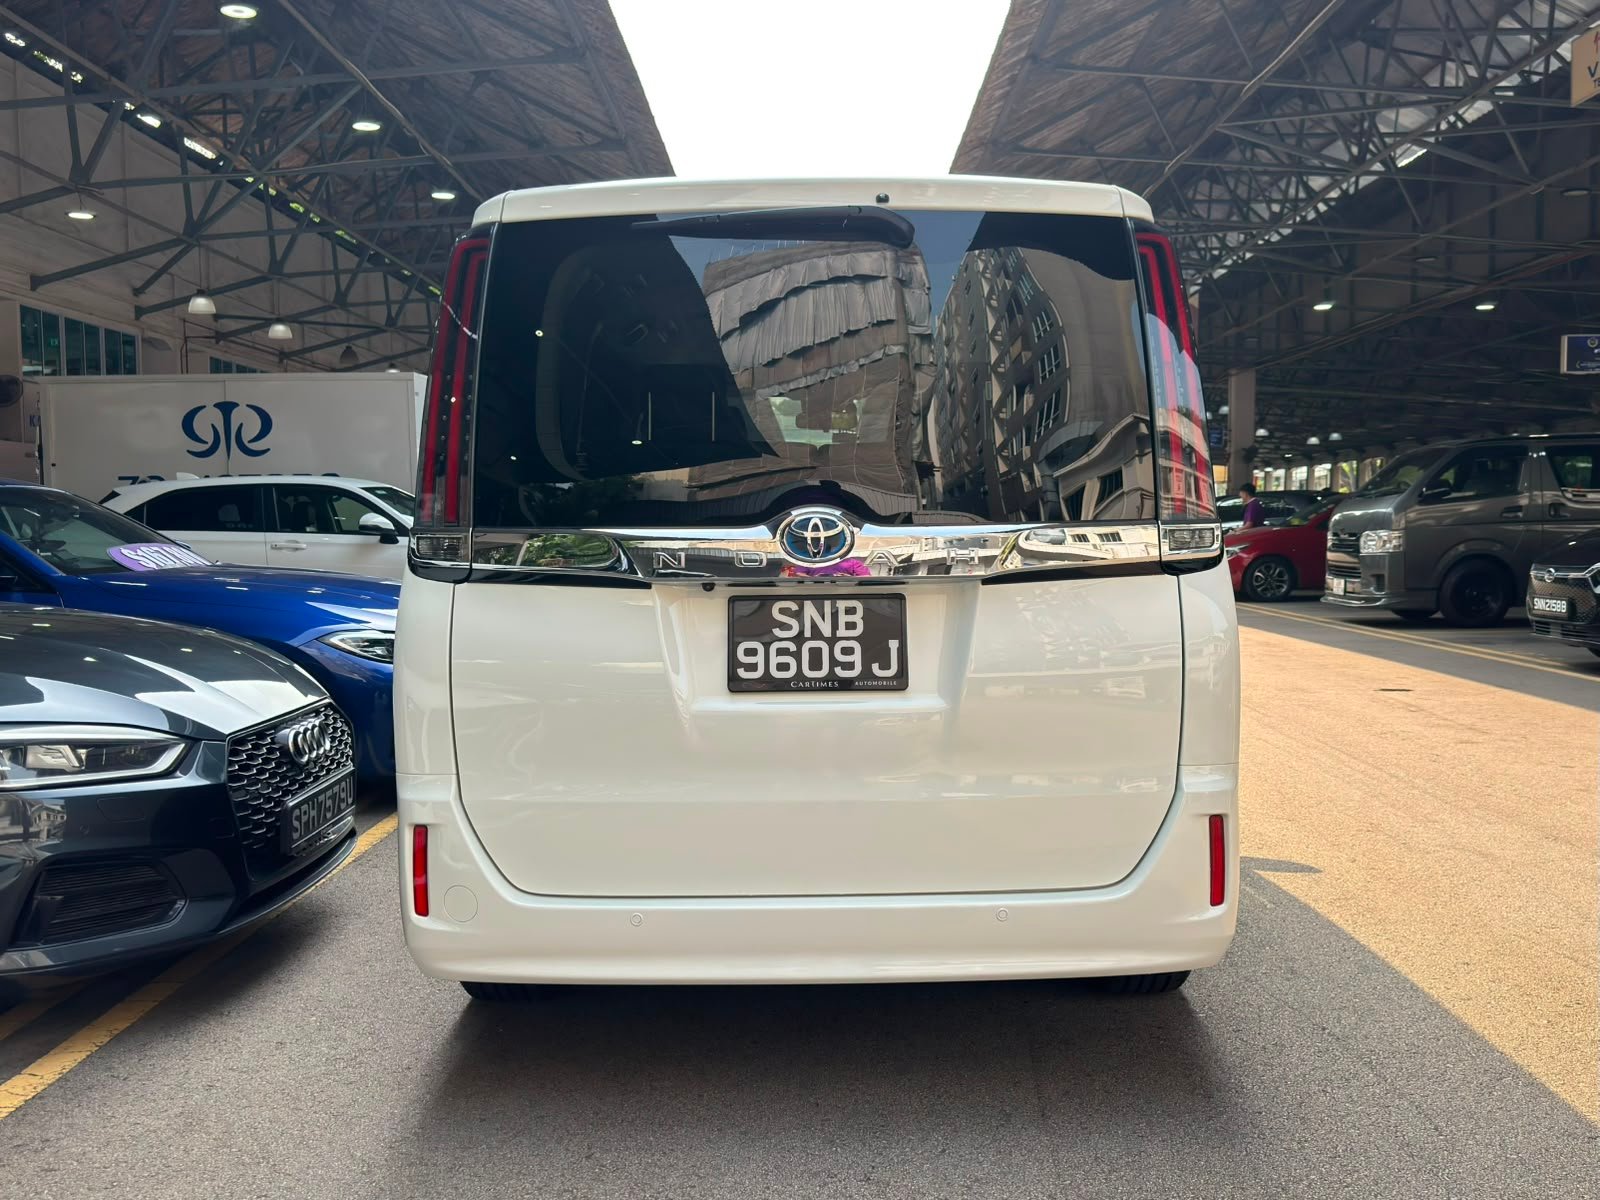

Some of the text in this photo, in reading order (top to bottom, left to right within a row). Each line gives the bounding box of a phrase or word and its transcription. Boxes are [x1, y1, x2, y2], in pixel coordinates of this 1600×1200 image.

[653, 547, 979, 568] NOAH
[771, 600, 864, 638] SNB
[292, 776, 354, 840] SPH7579U
